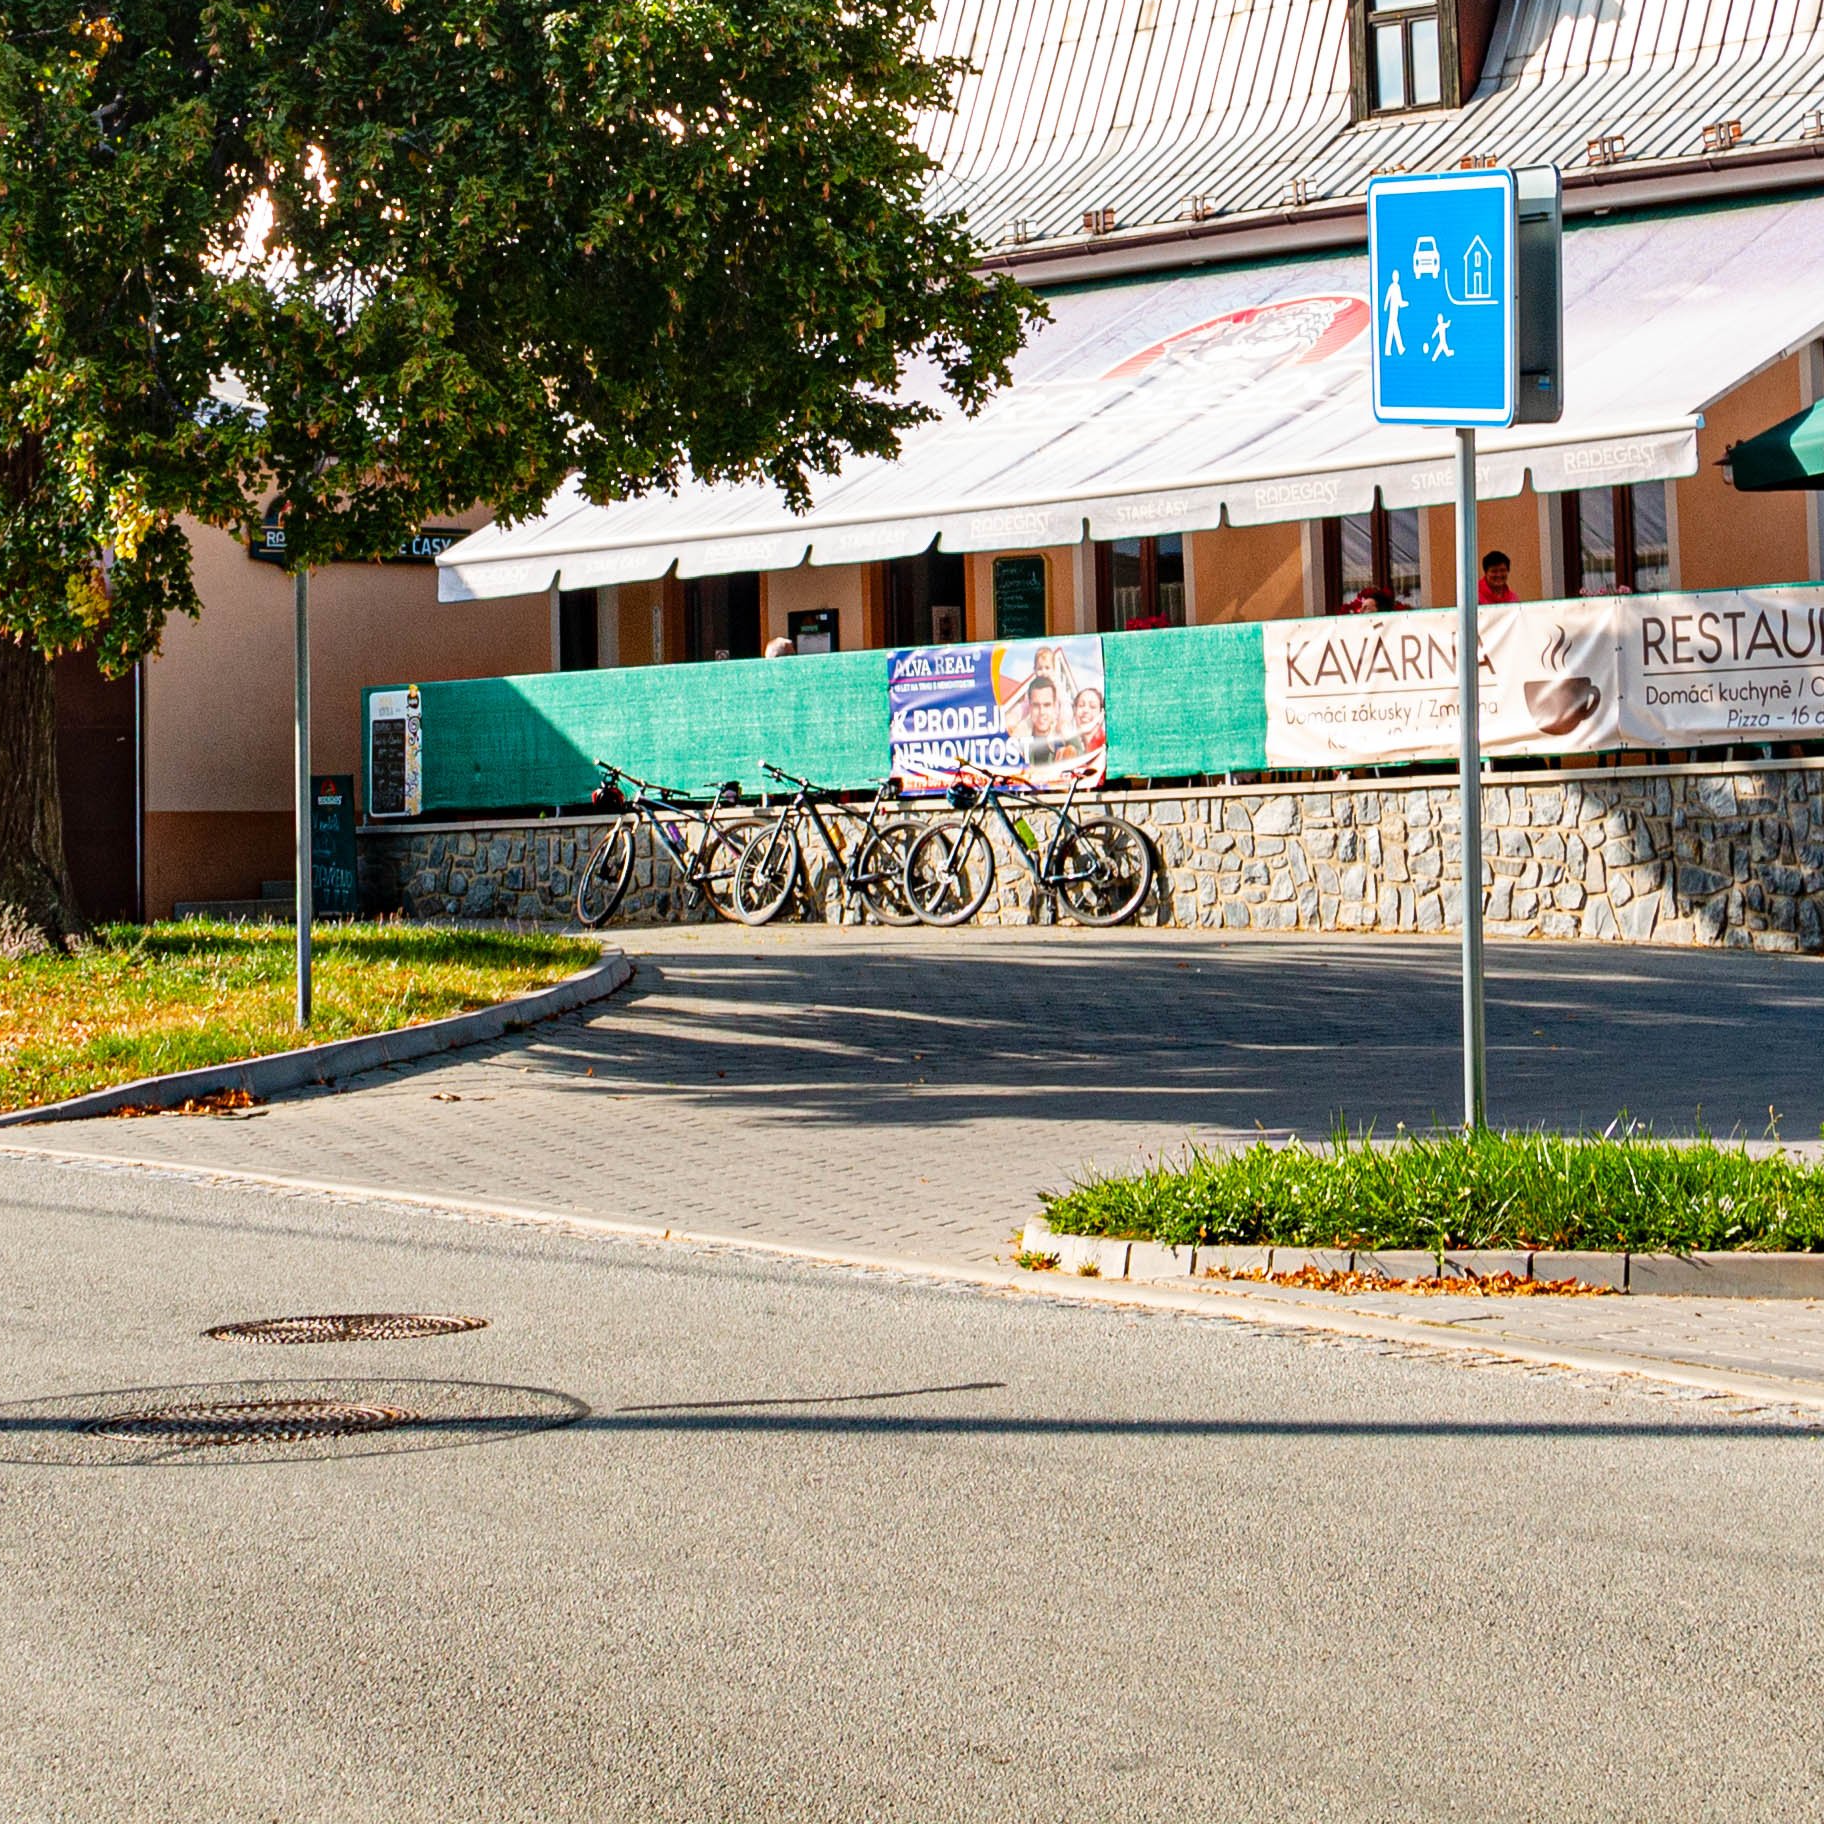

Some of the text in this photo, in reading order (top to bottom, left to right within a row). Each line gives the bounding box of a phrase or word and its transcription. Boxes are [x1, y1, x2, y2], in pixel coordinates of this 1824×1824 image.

[1563, 442, 1658, 474] RADEGAST
[1410, 466, 1454, 490] STARÉ
[1254, 479, 1341, 510] RADEGAST
[412, 534, 452, 556] ČASY
[894, 654, 931, 678] ALVA
[1646, 683, 1714, 705] Domácí
[1718, 678, 1792, 707] kuchyně
[892, 710, 908, 735] K
[1285, 704, 1347, 725] Domácí
[1351, 698, 1412, 727] zákusky
[1726, 708, 1771, 728] Pizza
[1791, 706, 1810, 726] 16
